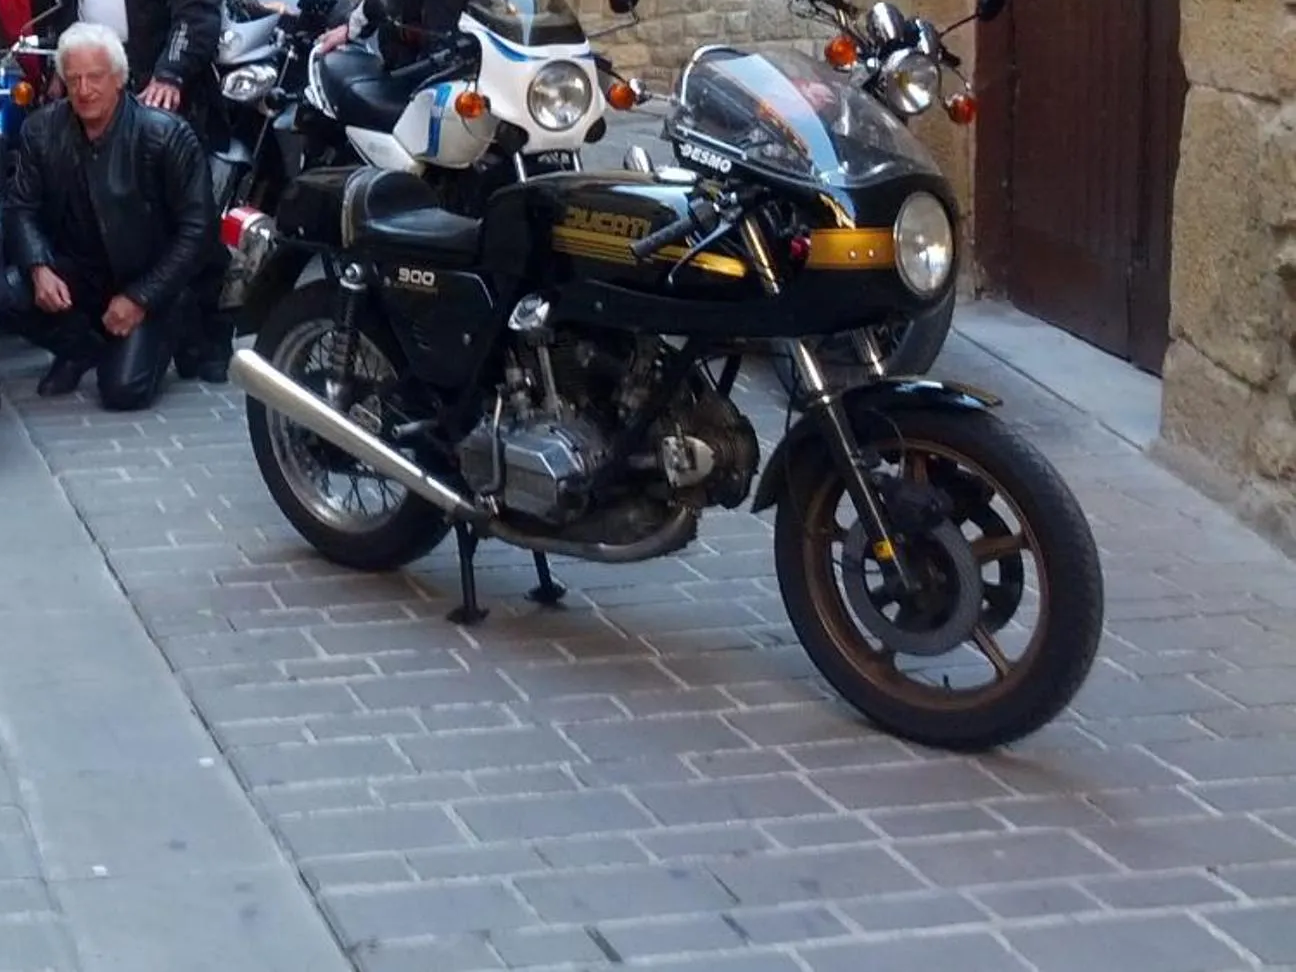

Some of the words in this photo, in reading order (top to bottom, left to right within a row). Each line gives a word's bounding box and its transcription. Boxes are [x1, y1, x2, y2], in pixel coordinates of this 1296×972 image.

[678, 143, 733, 174] DESMO
[565, 206, 653, 240] DUCATI
[398, 266, 435, 287] 900
